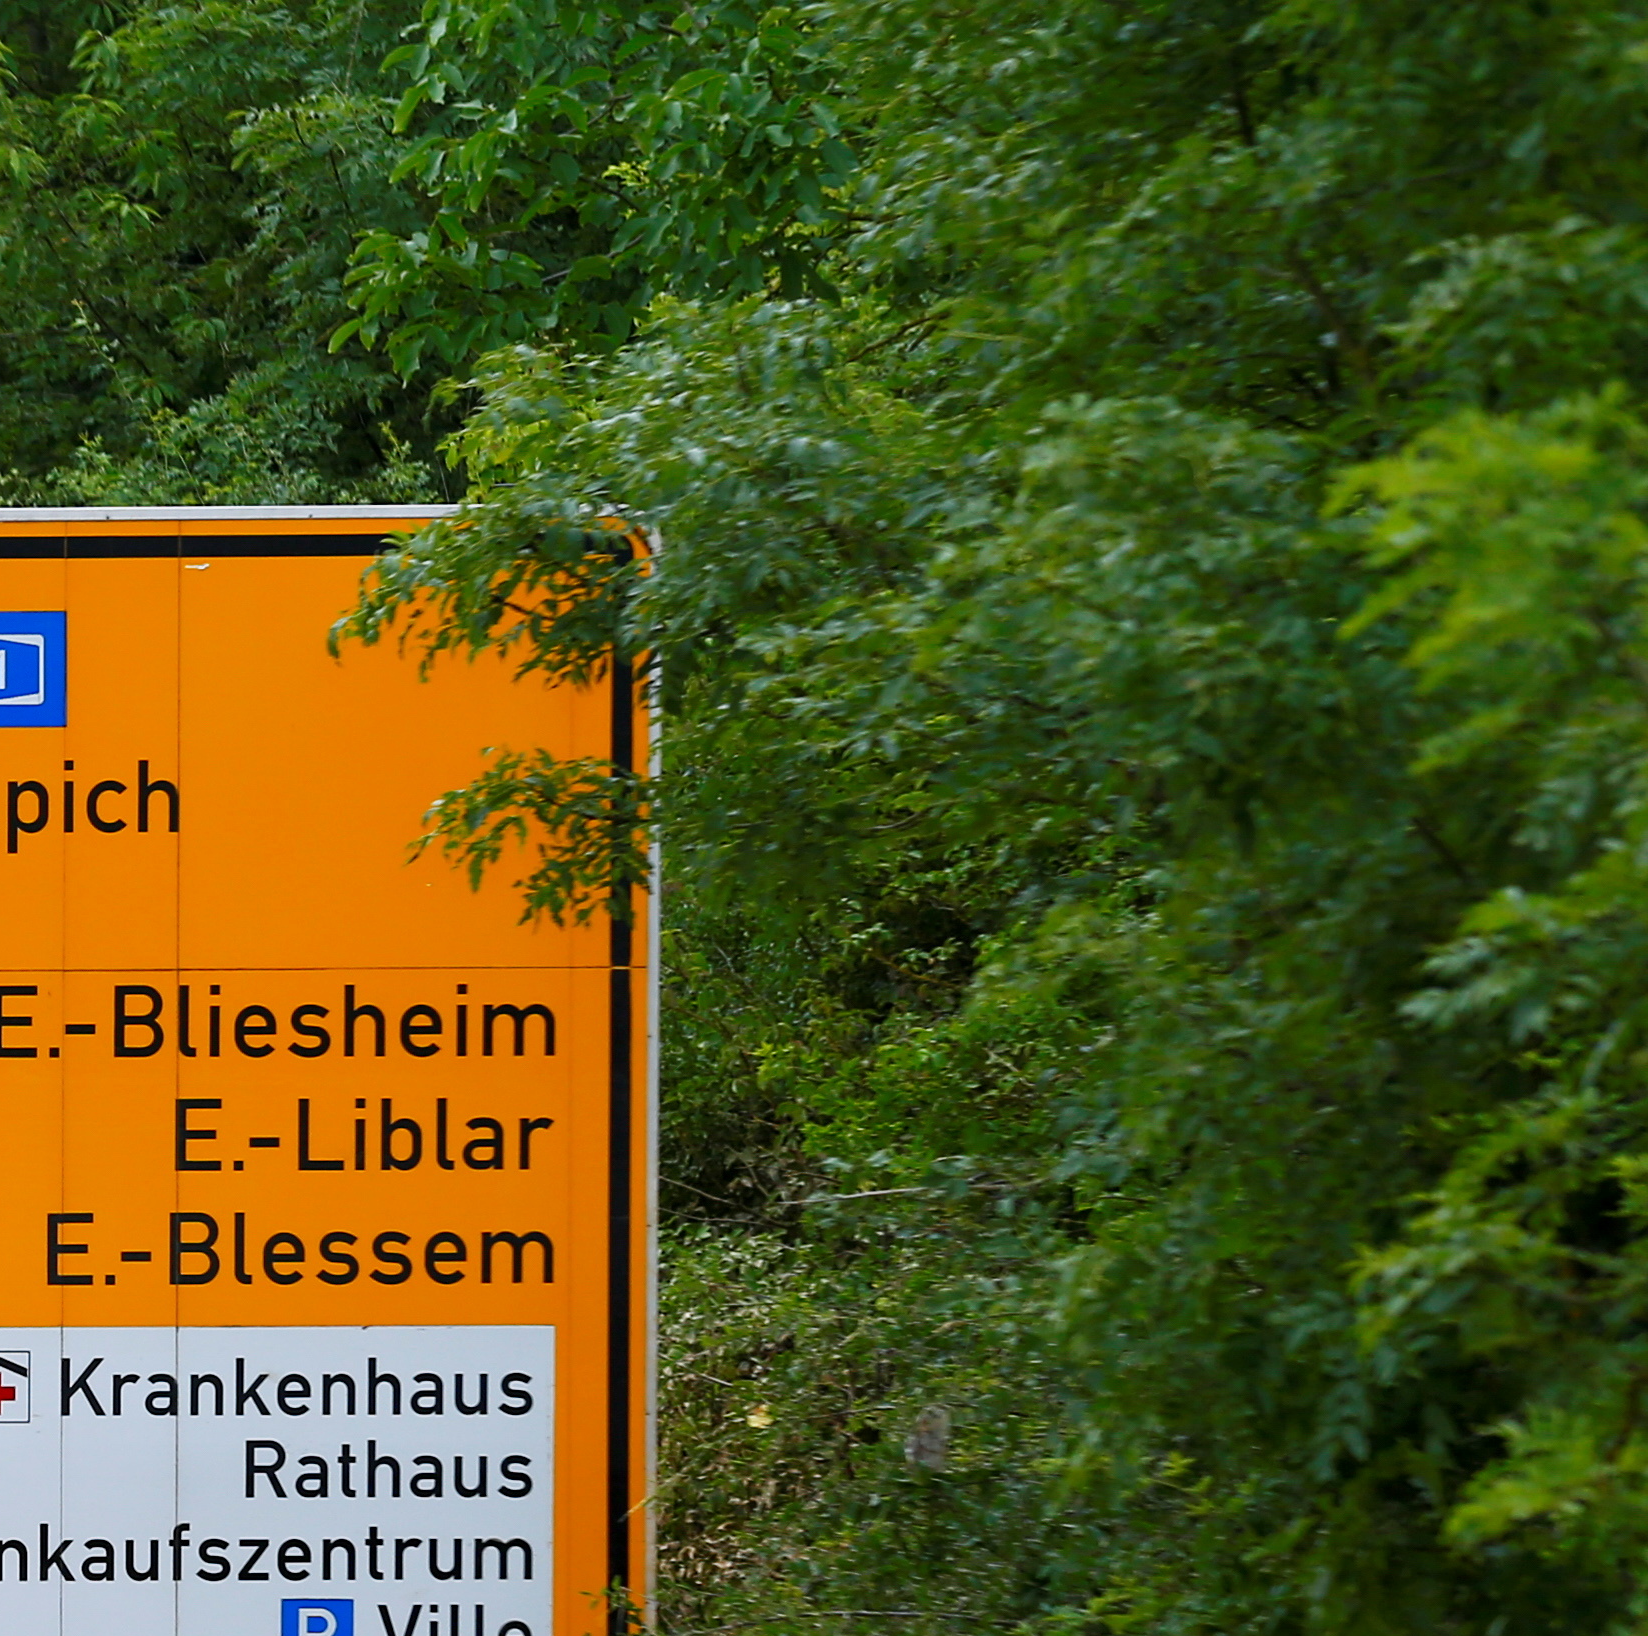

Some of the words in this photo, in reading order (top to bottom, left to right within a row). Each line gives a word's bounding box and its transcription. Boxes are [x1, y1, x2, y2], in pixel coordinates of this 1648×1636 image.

[175, 1097, 554, 1171] E.-Liblar
[47, 1212, 554, 1286] E.-Blessem
[60, 1357, 533, 1417] Krankenhaus
[245, 1439, 533, 1499] Rathaus
